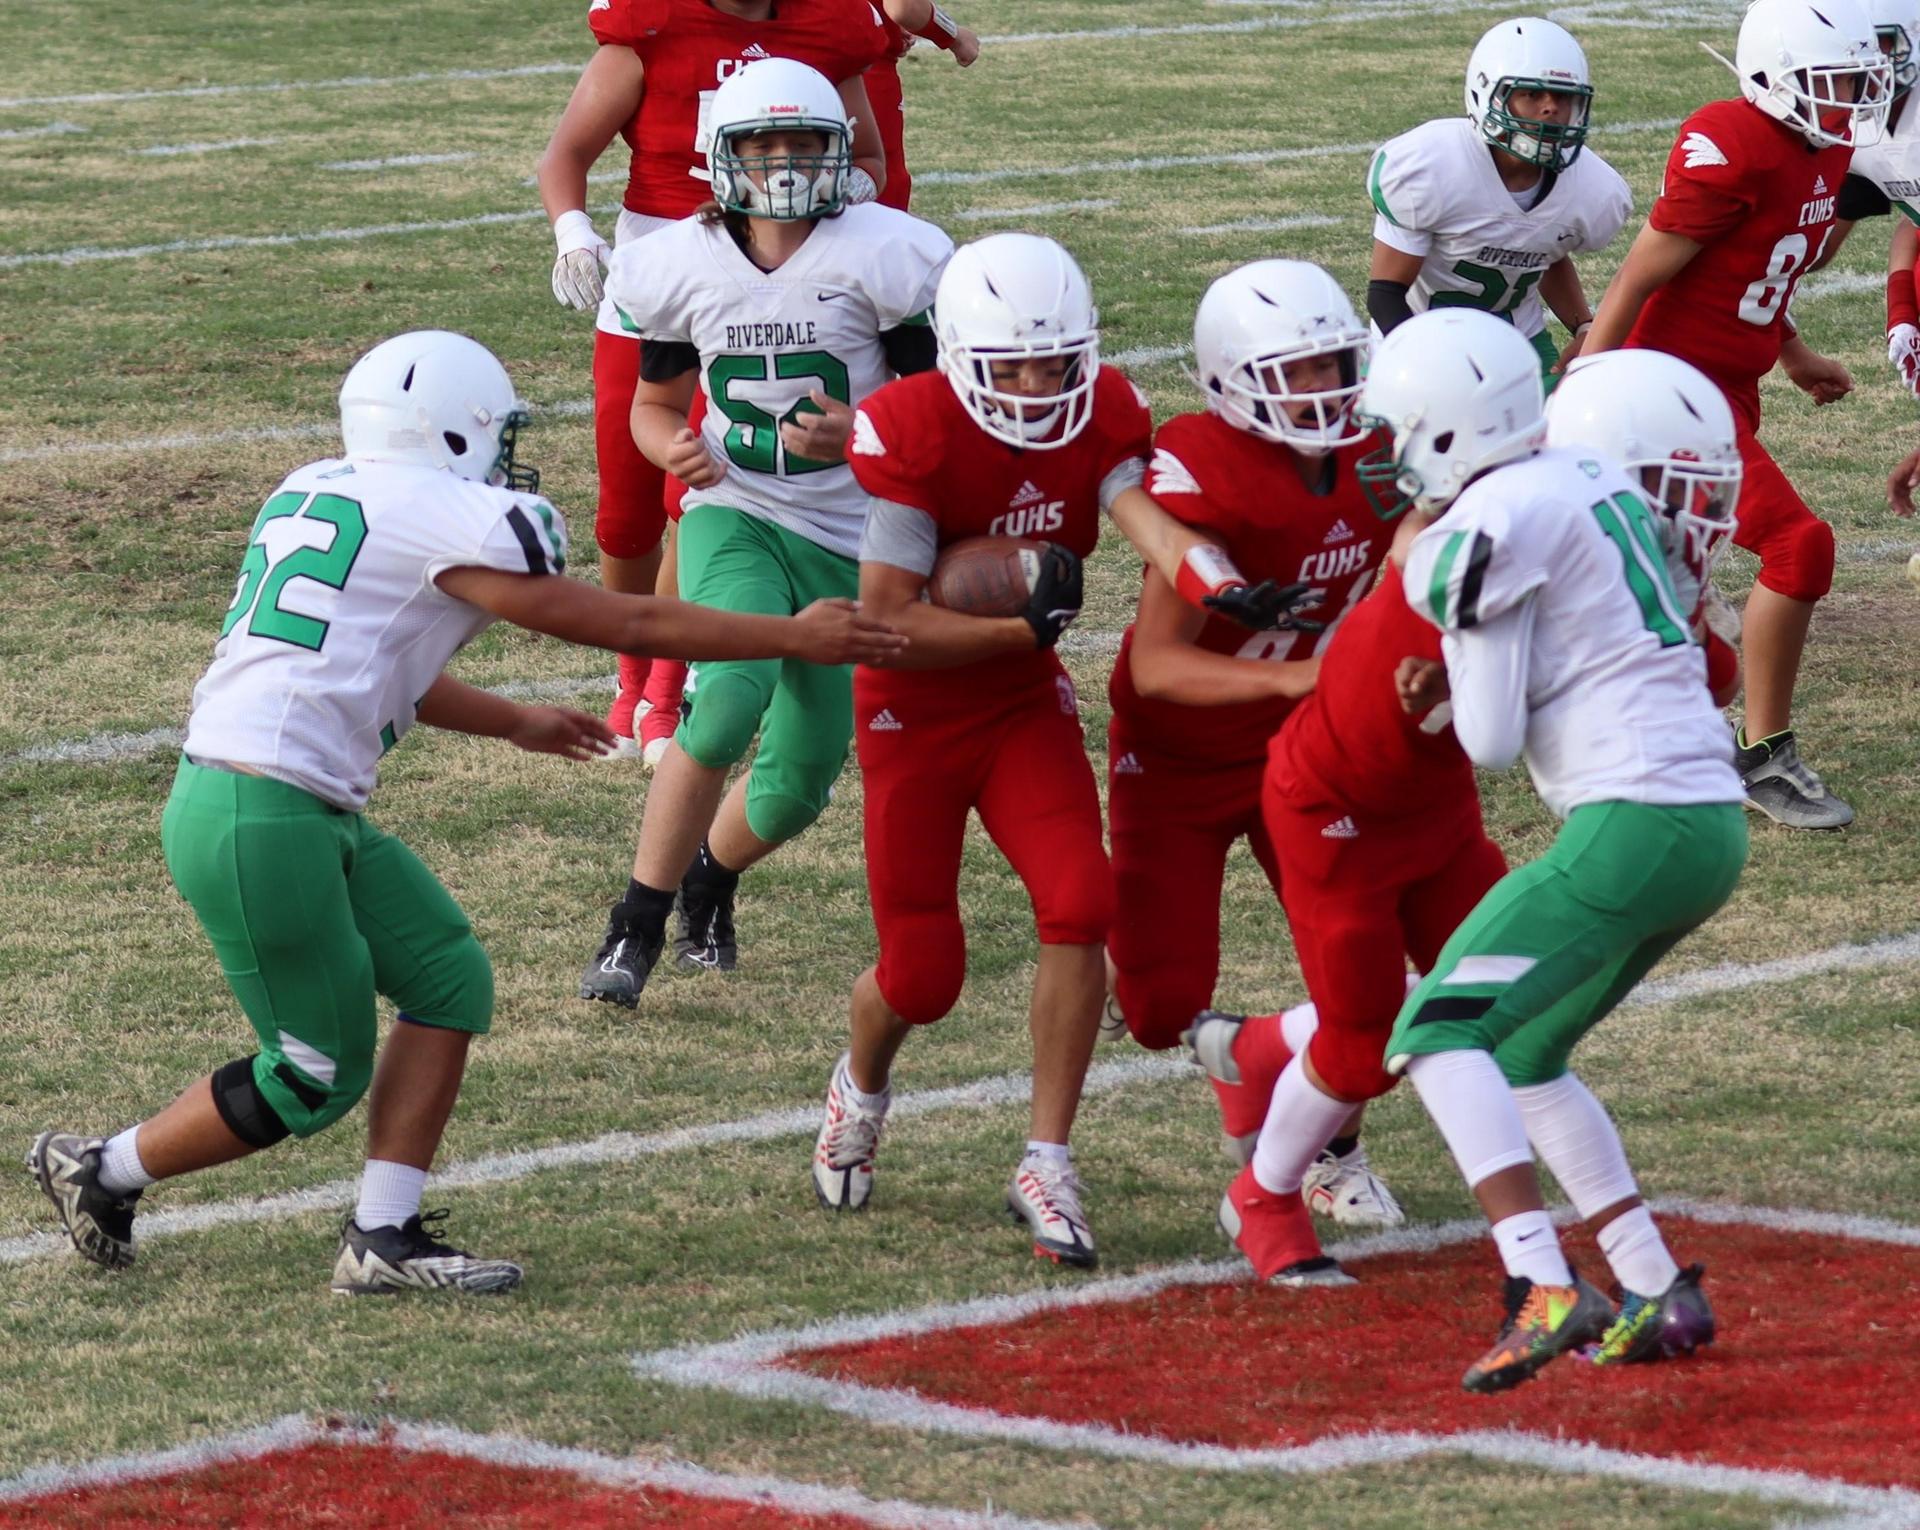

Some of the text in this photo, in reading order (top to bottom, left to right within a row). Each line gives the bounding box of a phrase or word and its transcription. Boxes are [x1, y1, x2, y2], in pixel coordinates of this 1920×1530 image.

[1798, 195, 1836, 227] CUHS
[1477, 245, 1548, 269] RIVERDALE
[726, 321, 817, 348] RIVERDALE
[988, 500, 1065, 536] CUHS
[1299, 539, 1372, 582] CUHS
